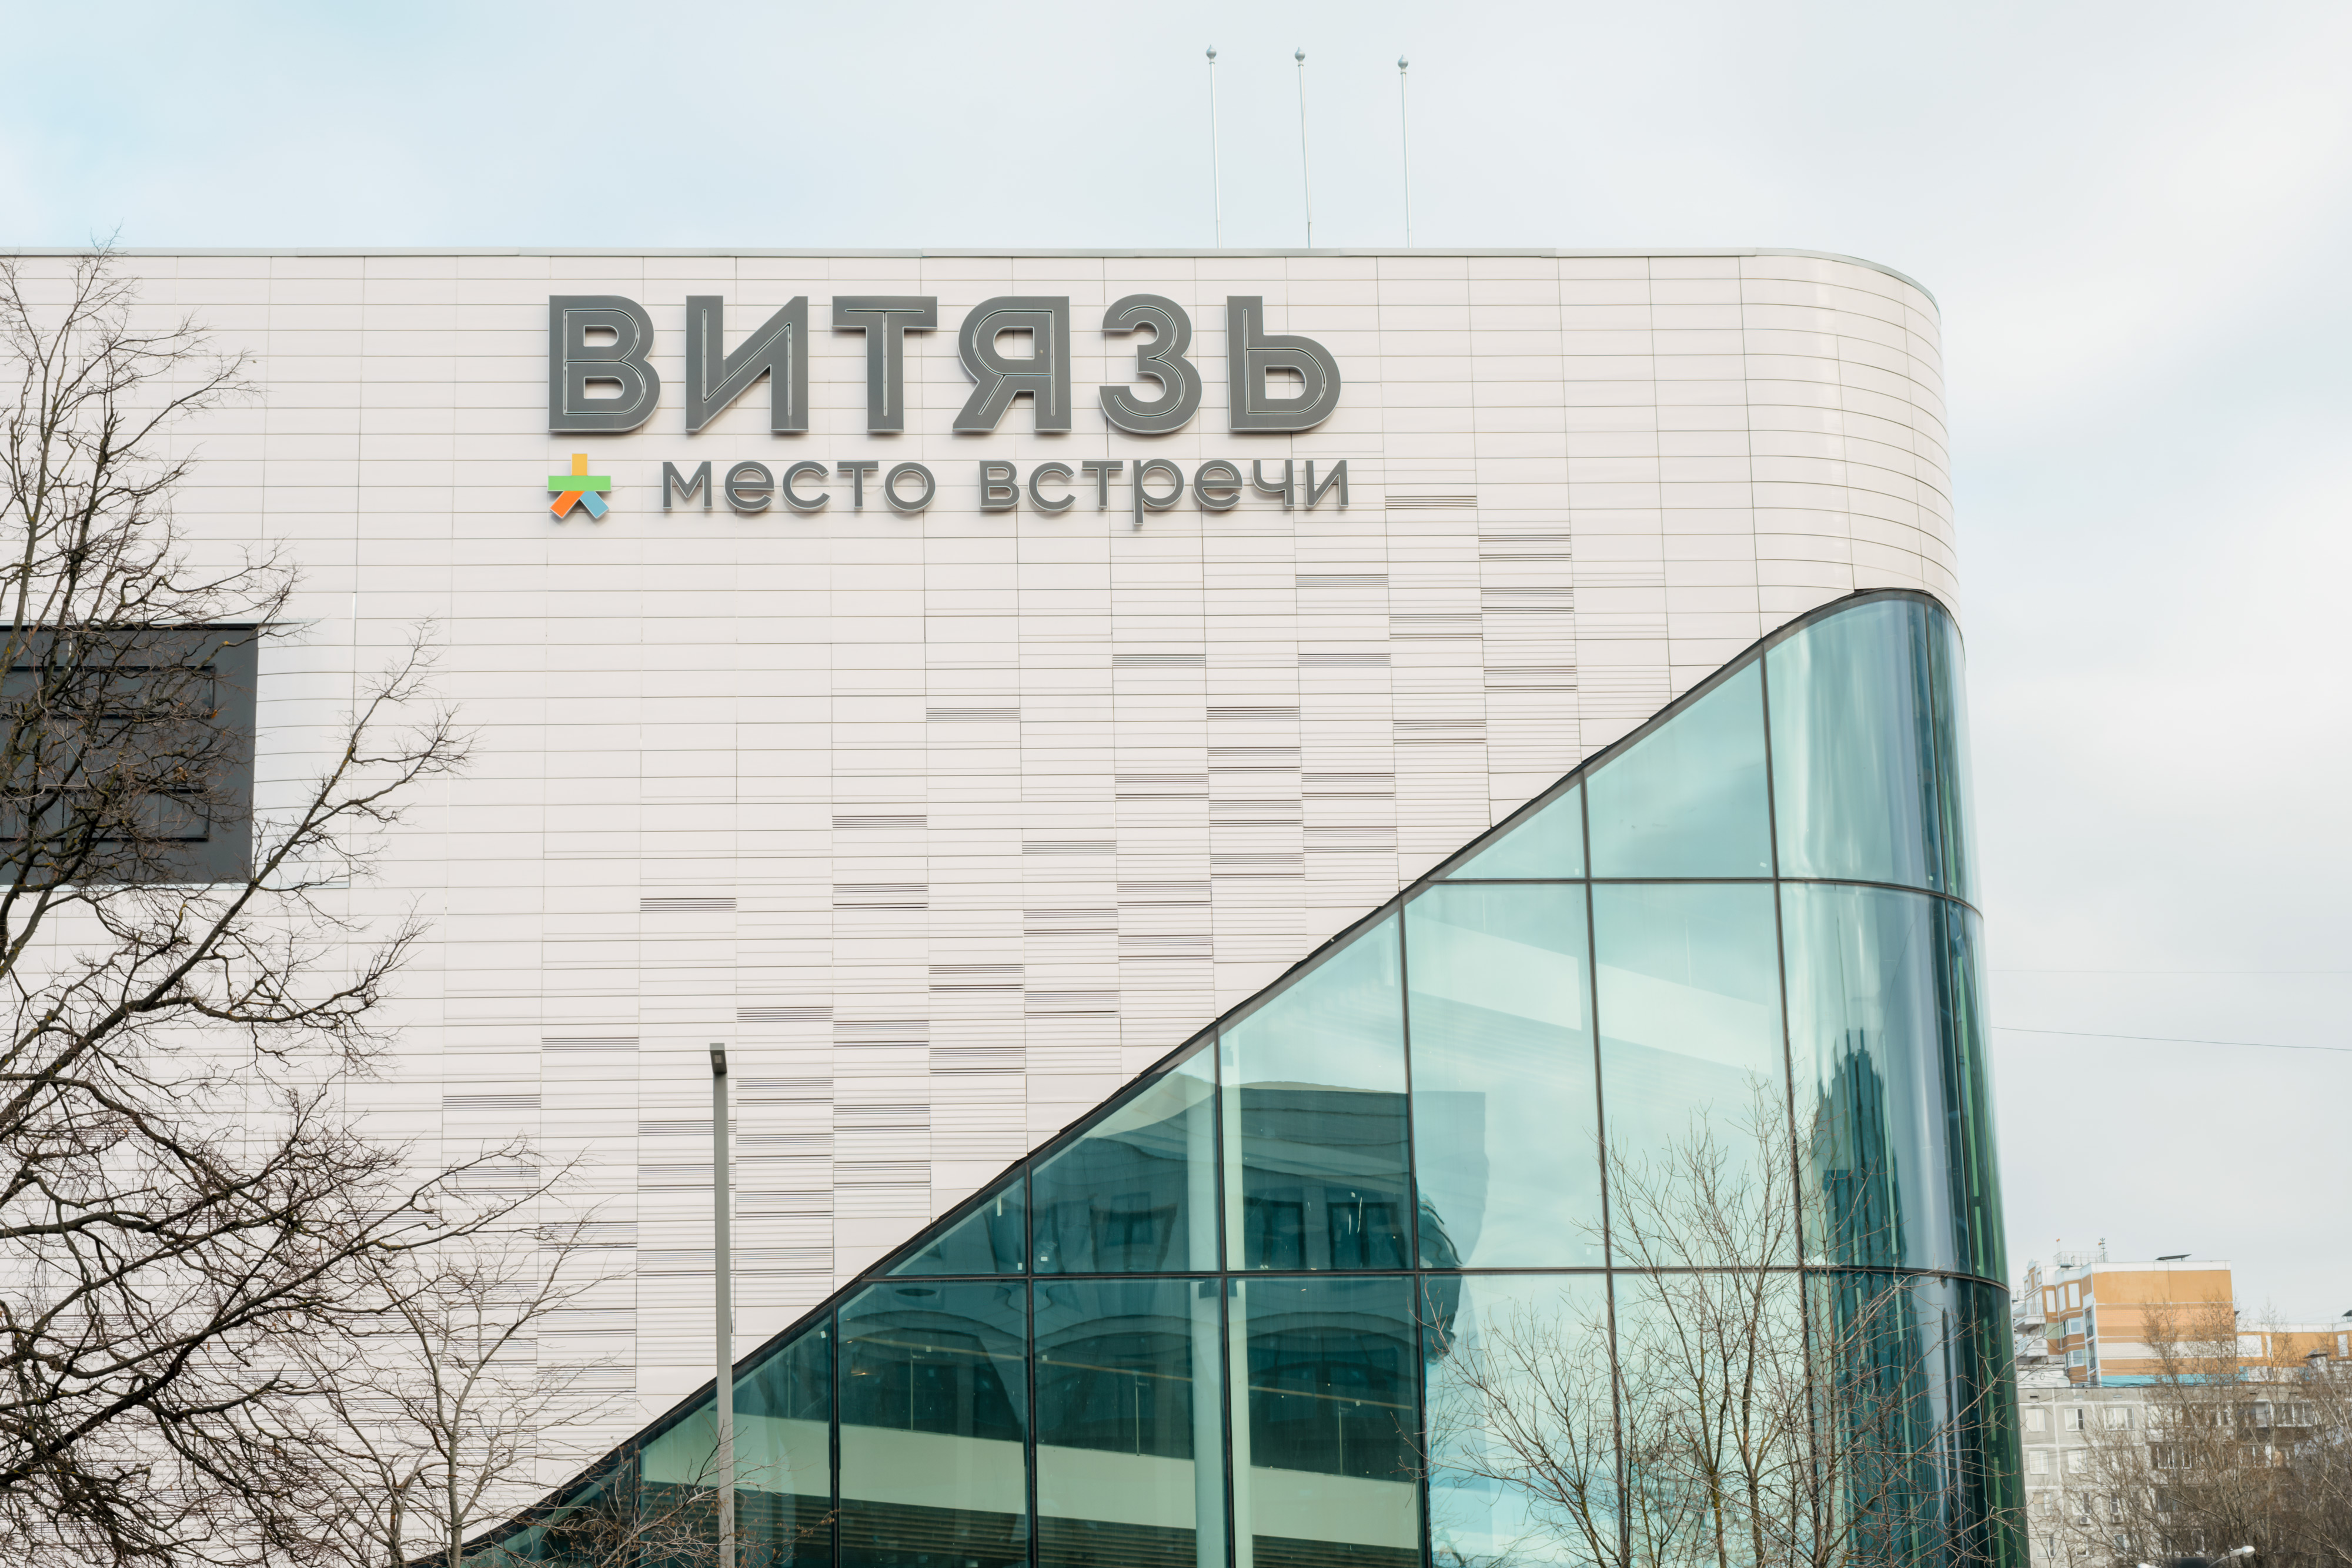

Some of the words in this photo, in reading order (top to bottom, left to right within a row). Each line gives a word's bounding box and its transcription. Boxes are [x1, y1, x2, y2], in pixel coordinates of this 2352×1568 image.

[548, 294, 1342, 434] ВИТЯЗЬ
[662, 460, 936, 513] место
[978, 459, 1349, 526] встречи
